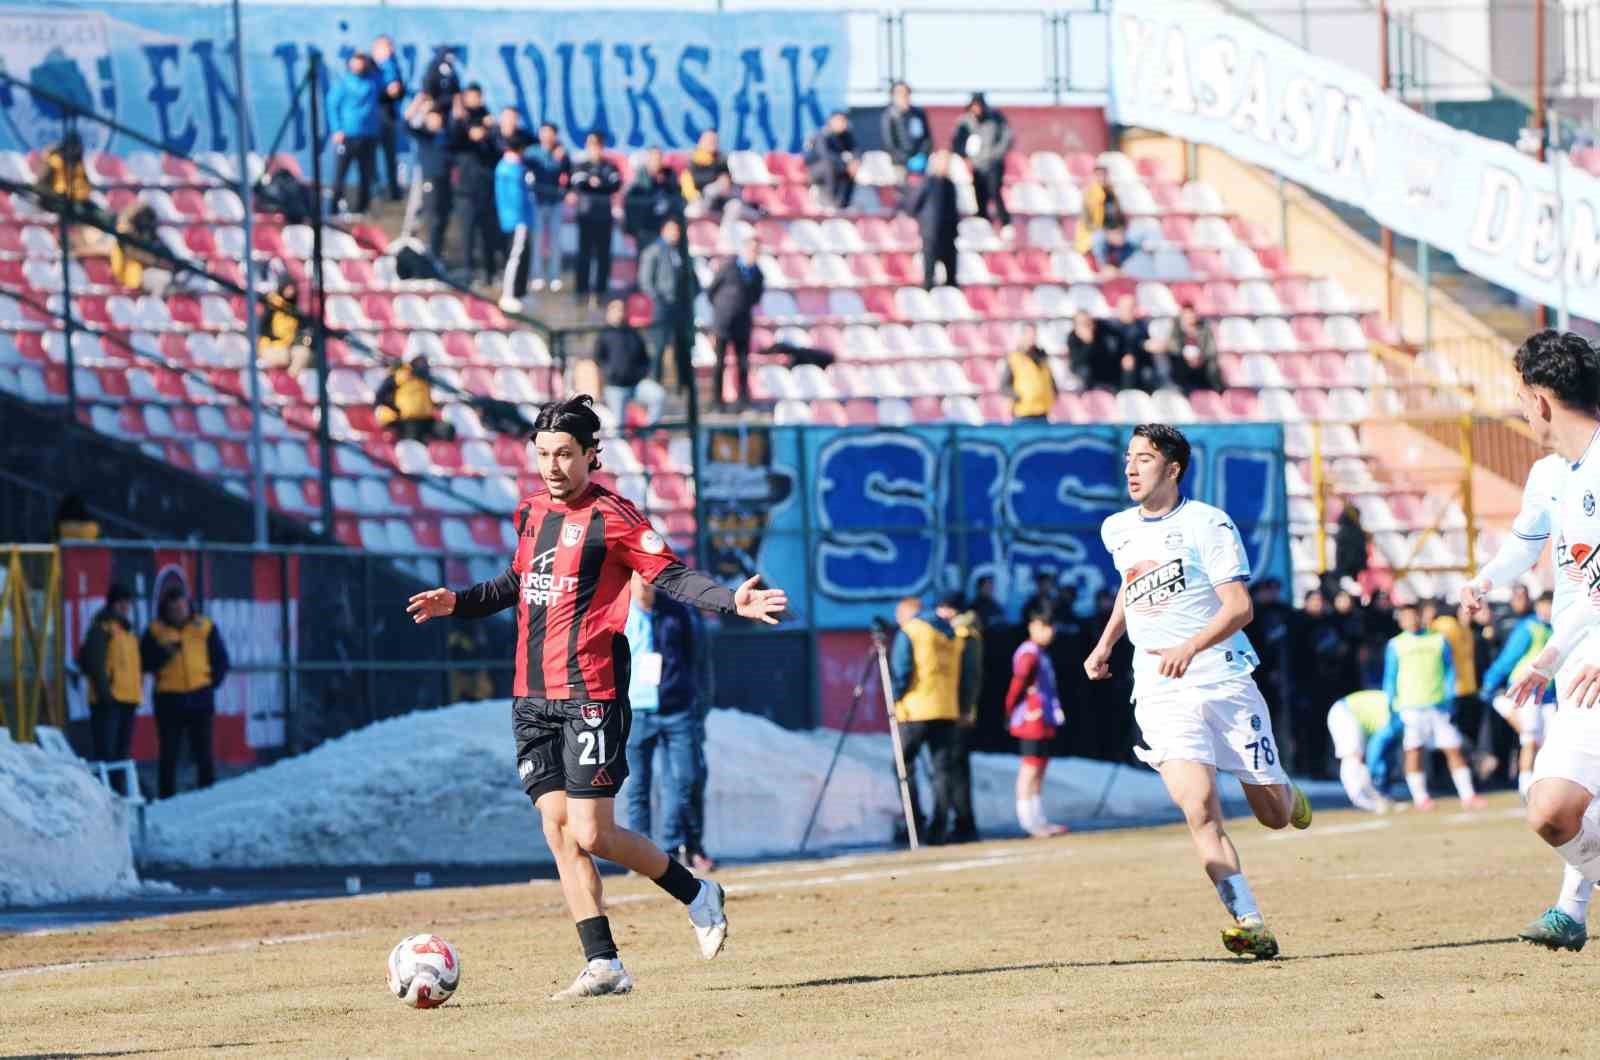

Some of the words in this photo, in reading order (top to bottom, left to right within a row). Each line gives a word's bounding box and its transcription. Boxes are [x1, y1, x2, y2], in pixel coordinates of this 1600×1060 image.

[141, 39, 256, 153] EN
[577, 728, 606, 766] 21
[1244, 736, 1275, 770] 78
